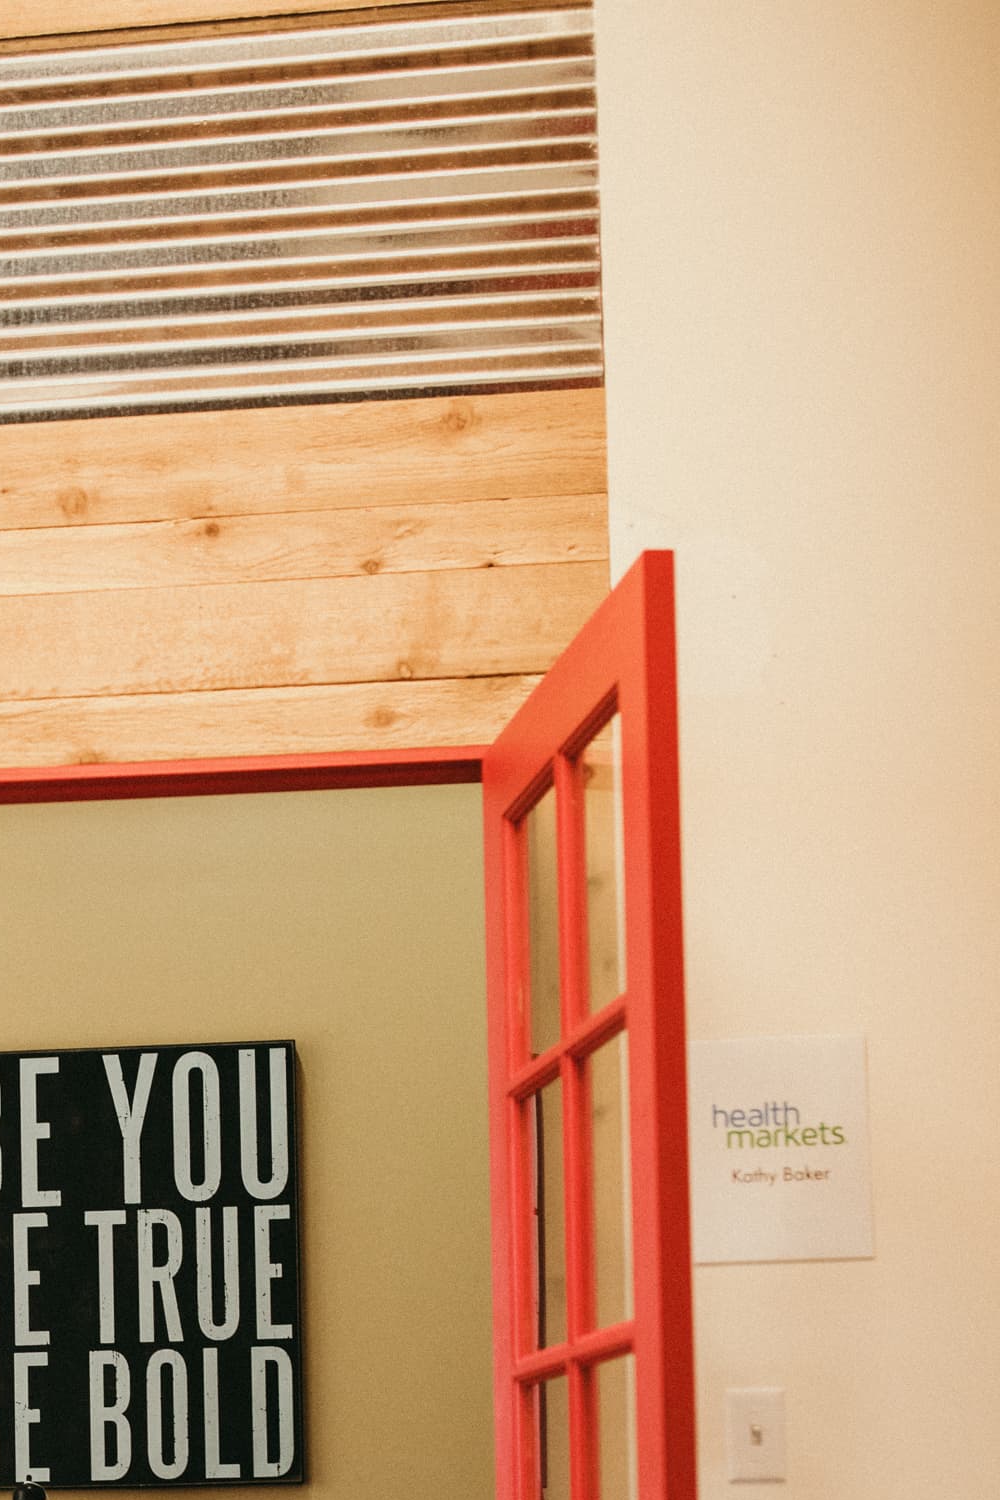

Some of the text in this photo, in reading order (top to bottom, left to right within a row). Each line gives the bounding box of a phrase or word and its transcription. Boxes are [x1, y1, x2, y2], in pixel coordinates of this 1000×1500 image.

[102, 1047, 289, 1204] YOU
[712, 1101, 800, 1128] health
[727, 1122, 845, 1149] markets
[732, 1164, 831, 1186] Kathy Baker
[84, 1204, 293, 1344] TRUE
[89, 1345, 295, 1481] BOLD
